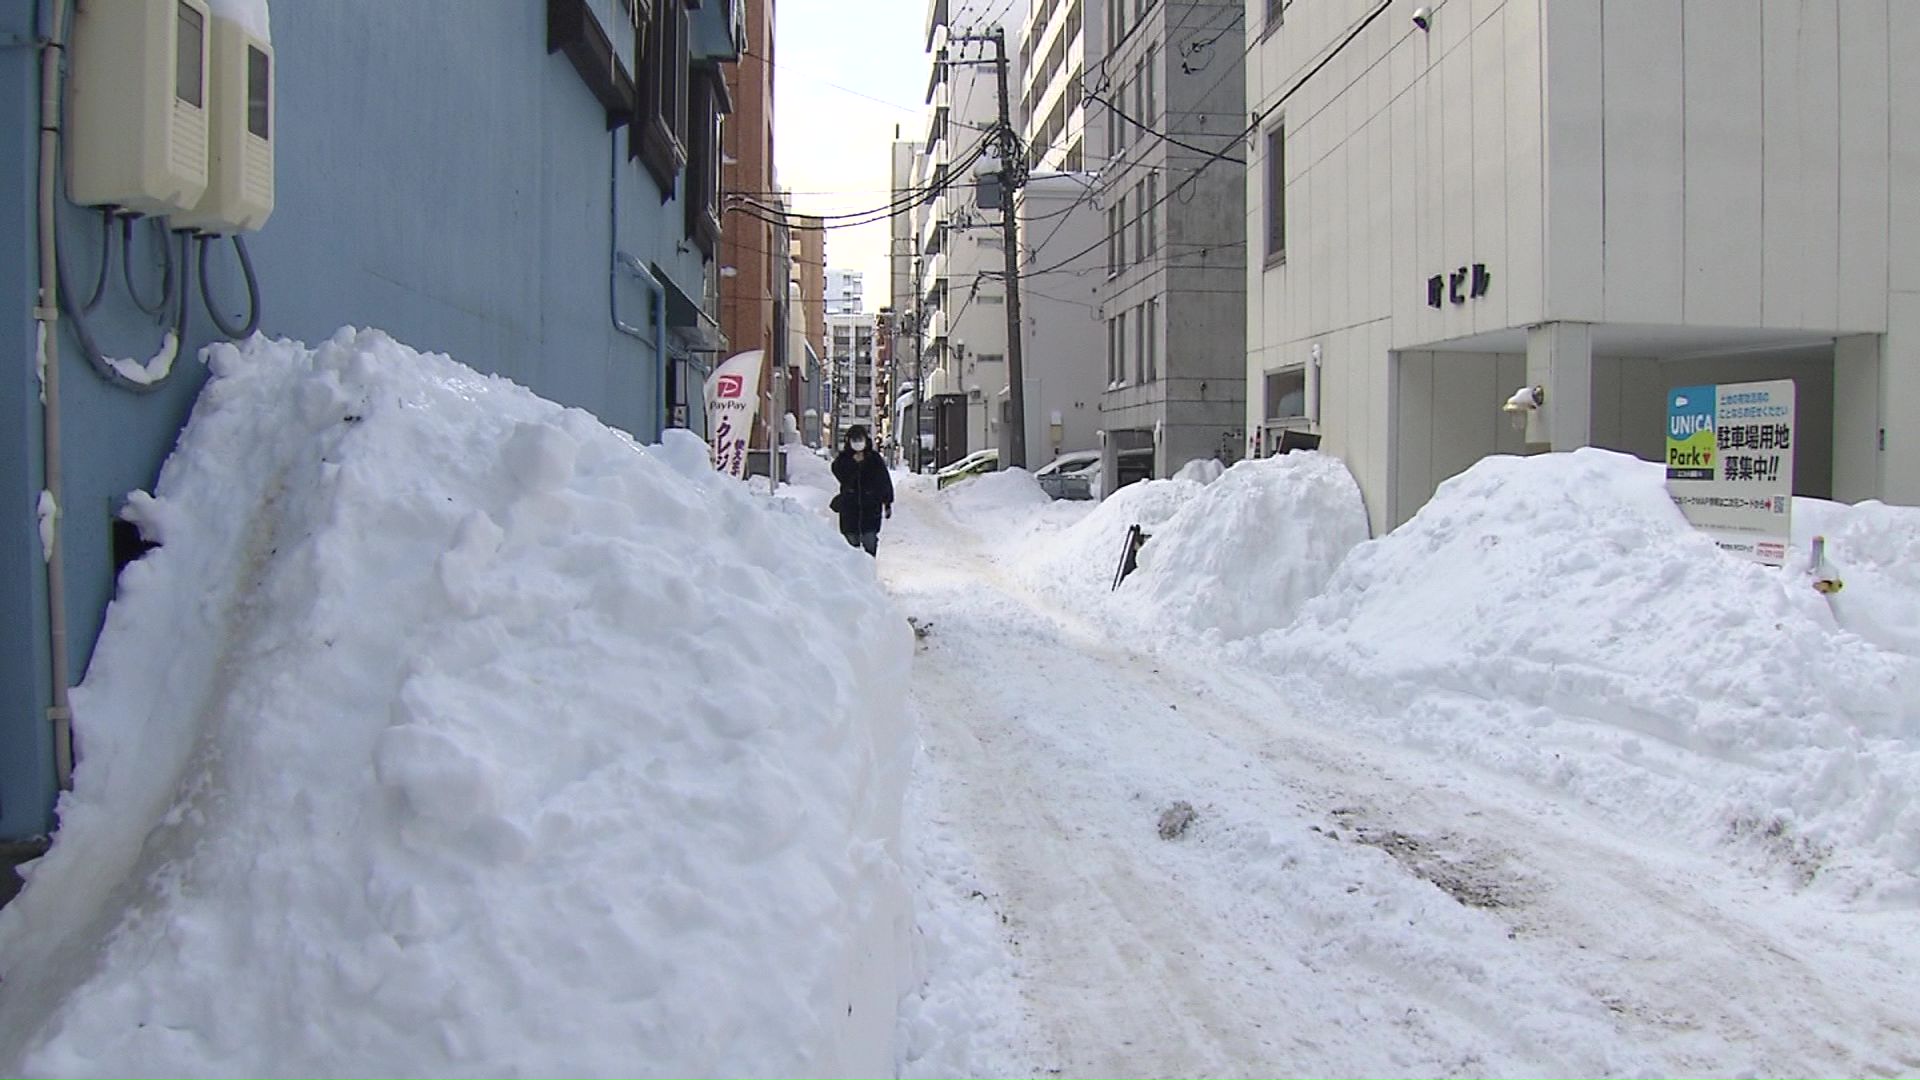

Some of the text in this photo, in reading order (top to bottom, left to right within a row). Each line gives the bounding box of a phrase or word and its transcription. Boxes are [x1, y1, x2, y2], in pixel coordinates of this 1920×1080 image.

[709, 401, 747, 412] PayPay
[1671, 414, 1713, 435] UNICA
[1717, 423, 1790, 450] 駐車場用地
[1670, 446, 1700, 465] Park
[1724, 455, 1780, 481] 募集中!!
